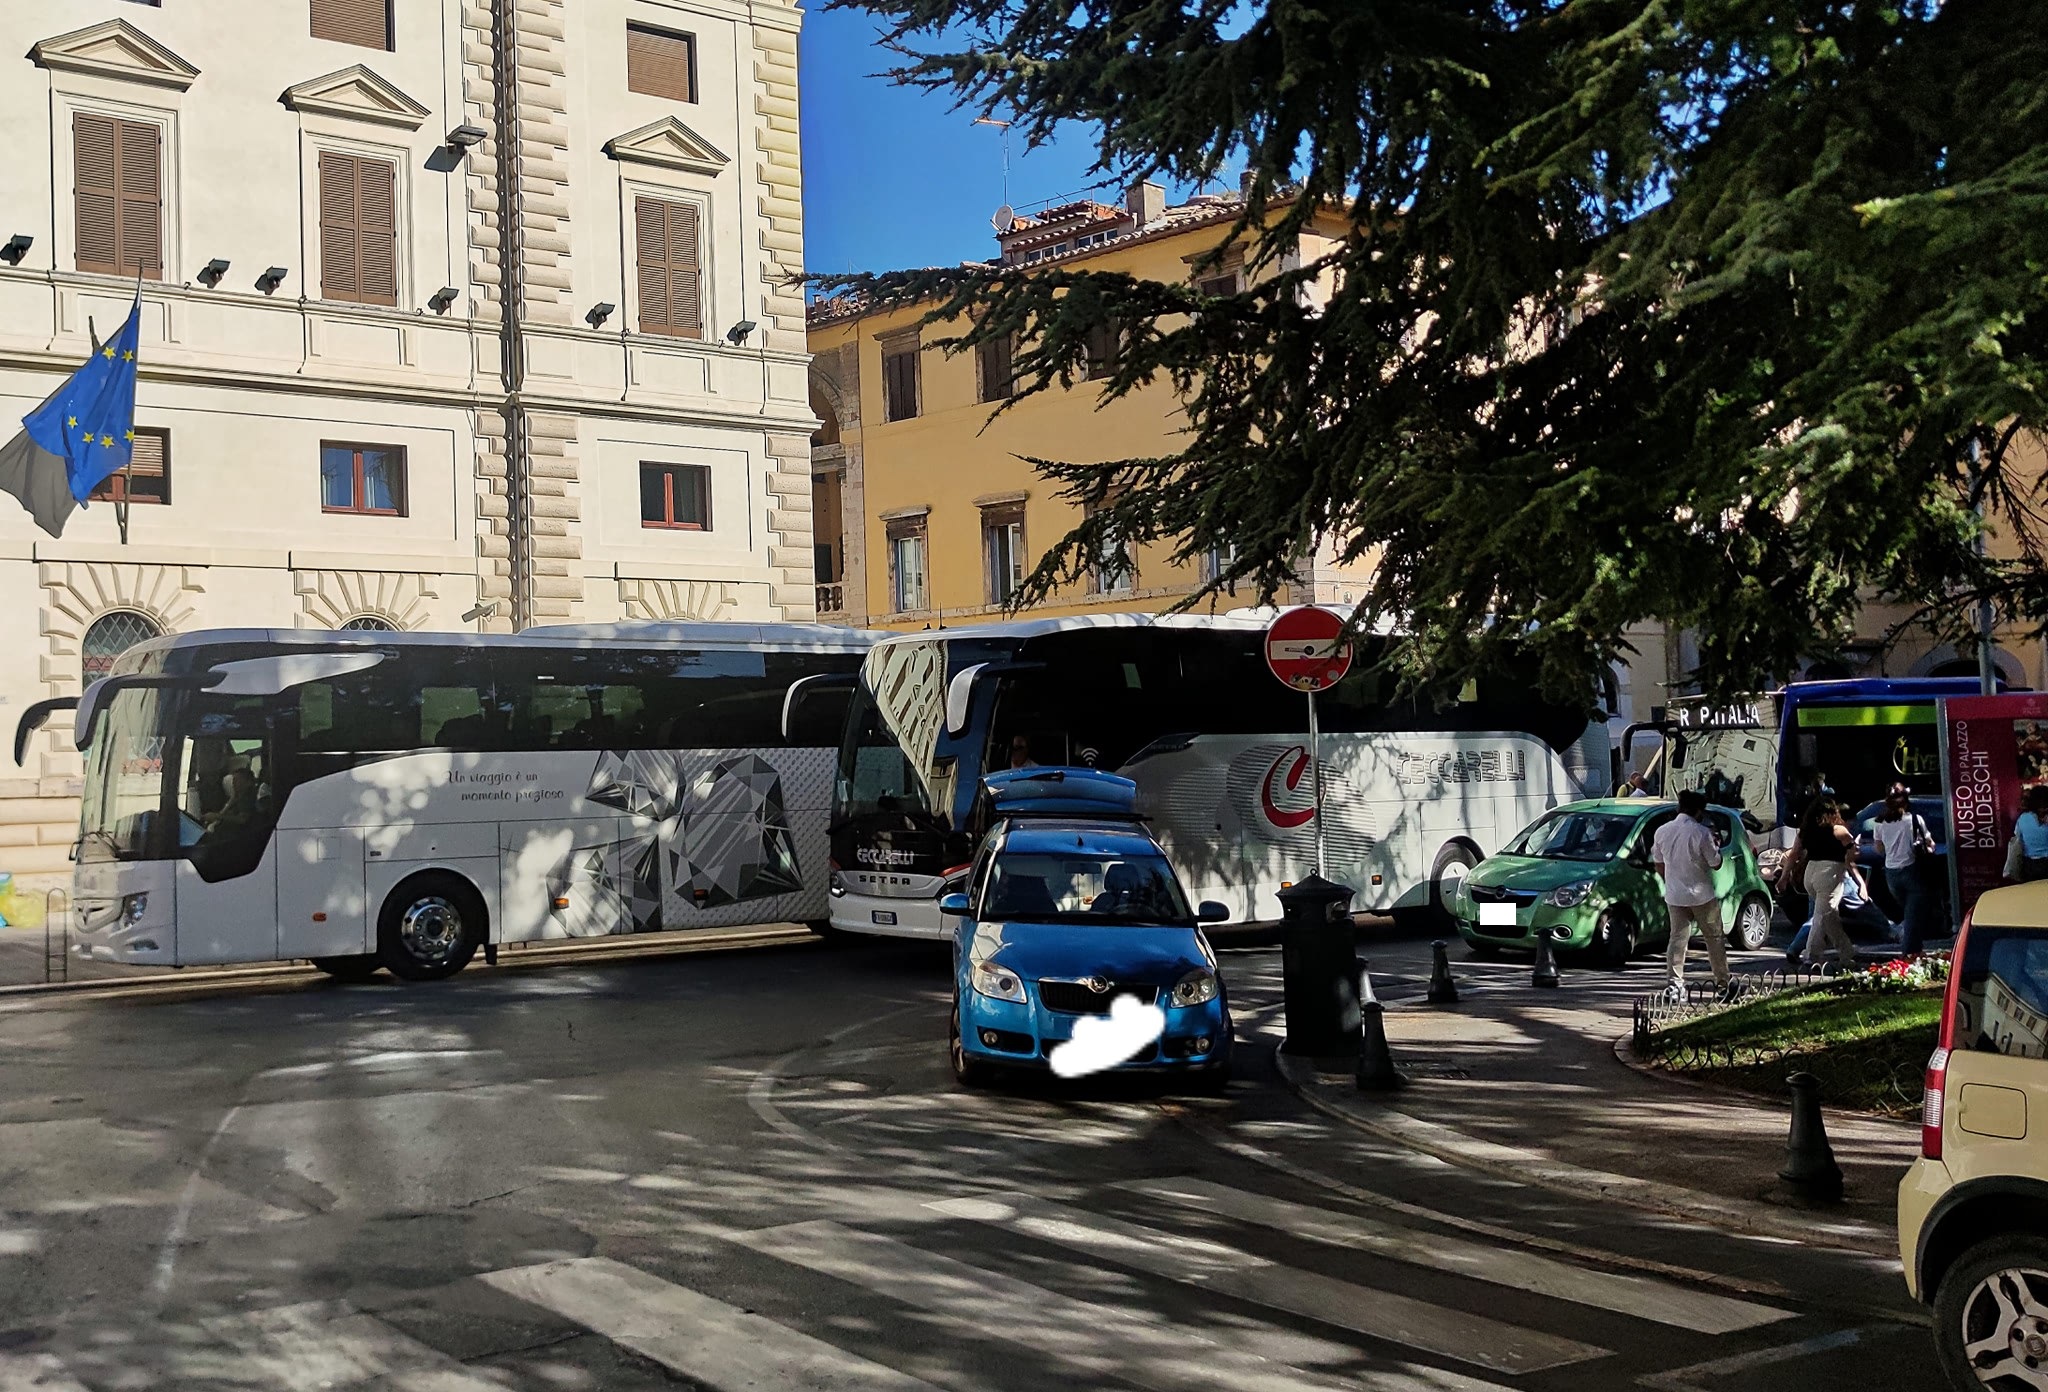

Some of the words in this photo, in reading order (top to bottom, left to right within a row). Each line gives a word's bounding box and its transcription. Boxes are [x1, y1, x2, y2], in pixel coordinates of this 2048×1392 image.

[1680, 707, 1690, 727] R
[1956, 720, 1971, 769] PALAZZO
[448, 769, 466, 783] Un
[470, 772, 512, 785] viaggio
[526, 773, 538, 781] un
[1396, 750, 1526, 785] CECCARELLI
[1960, 772, 1972, 783] DI
[461, 789, 511, 801] momento
[515, 789, 564, 803] prezioso
[1972, 751, 1996, 849] BALDESCHI
[1955, 785, 1977, 849] MUSEO
[859, 875, 911, 885] SETRA
